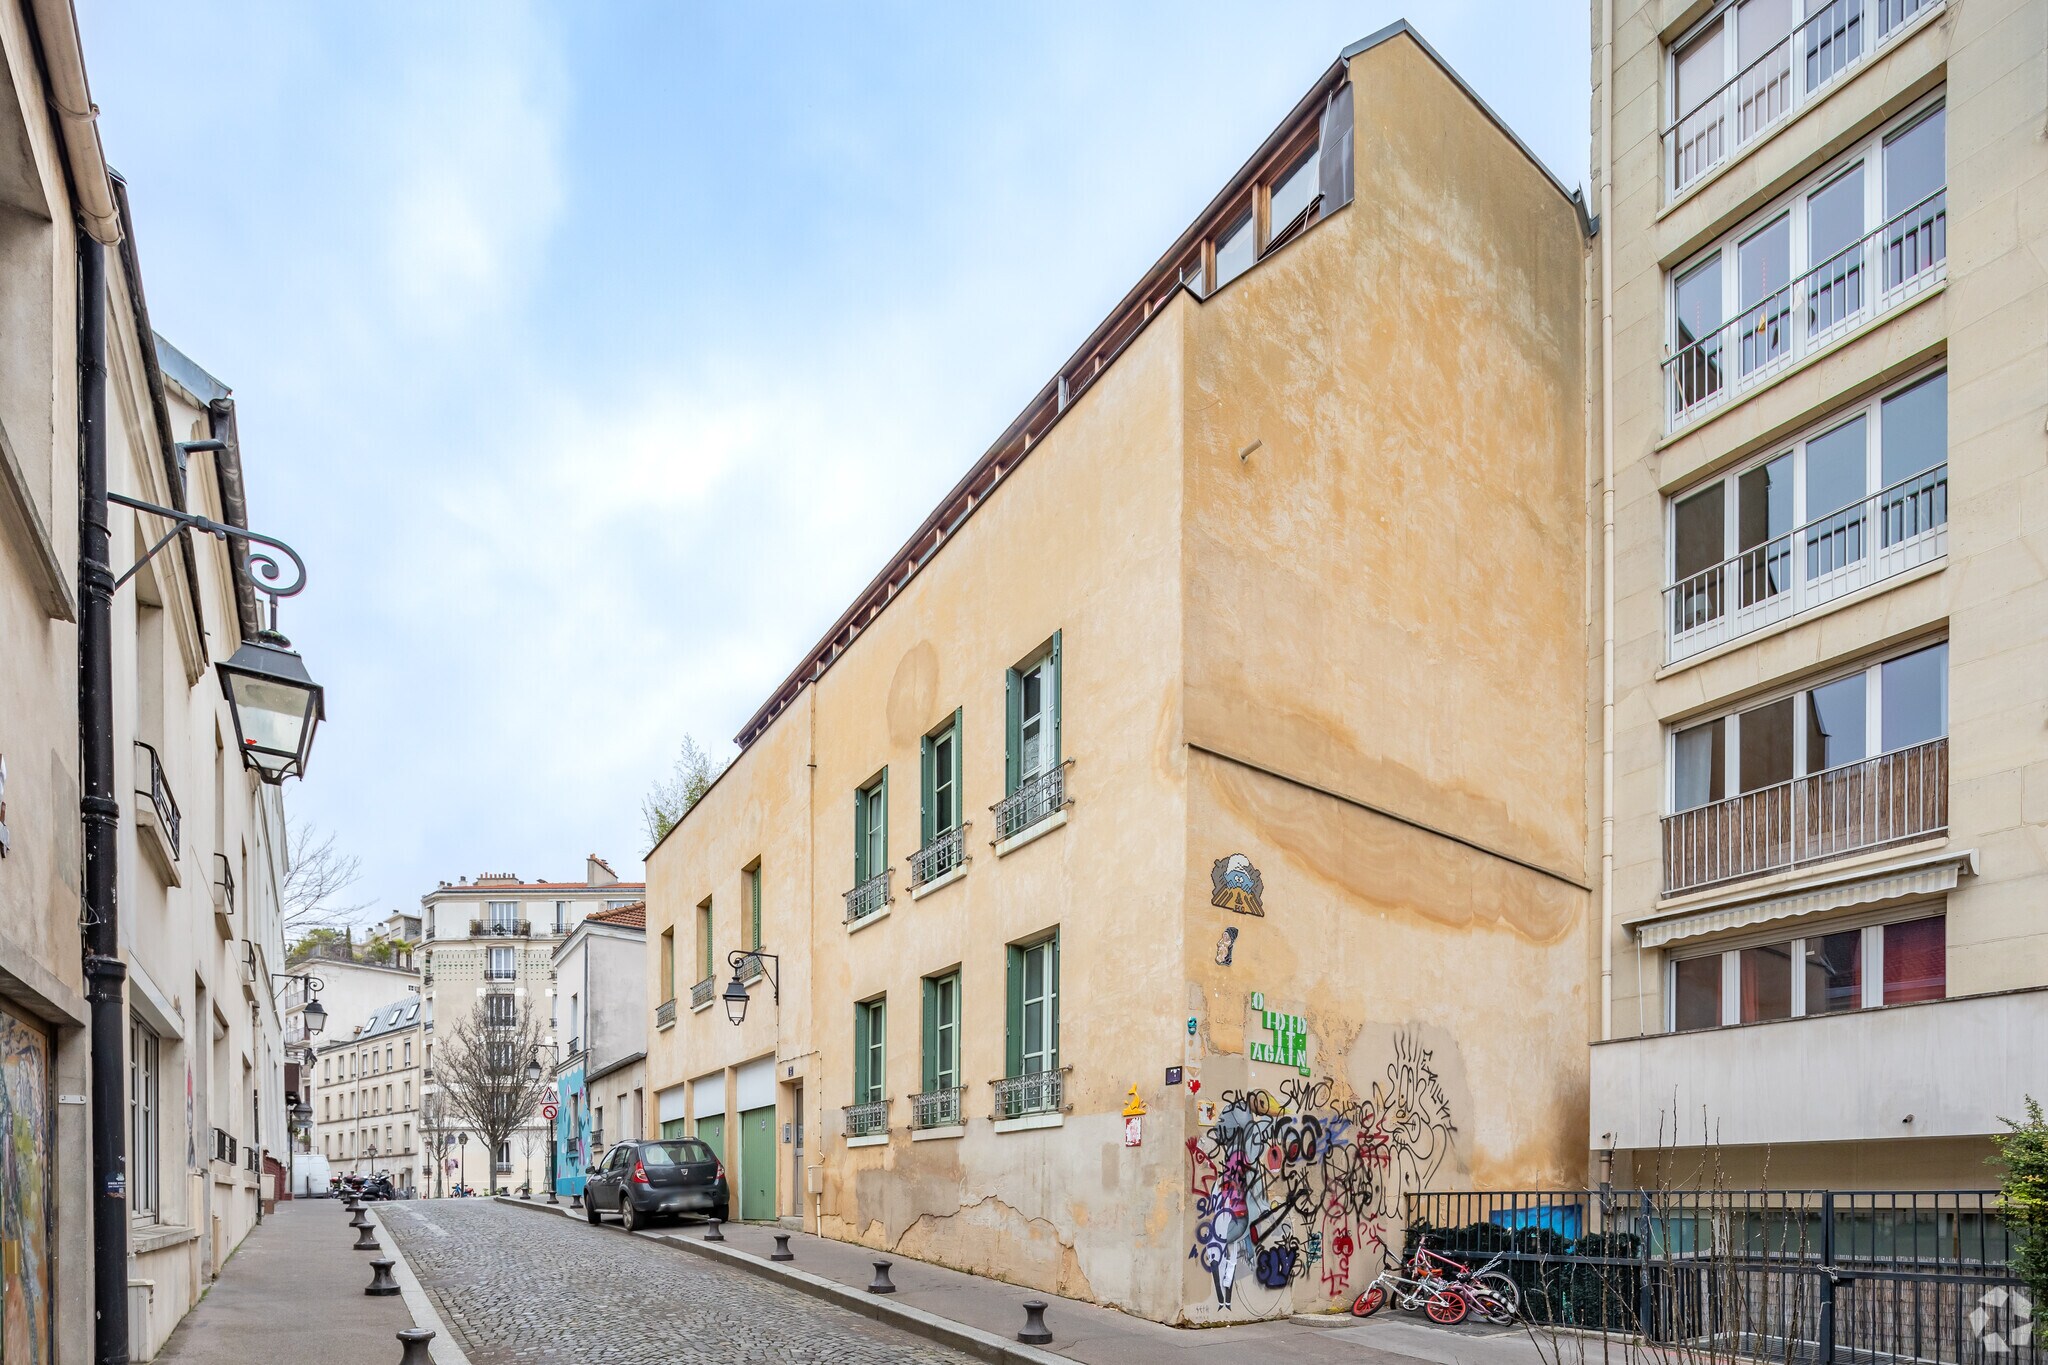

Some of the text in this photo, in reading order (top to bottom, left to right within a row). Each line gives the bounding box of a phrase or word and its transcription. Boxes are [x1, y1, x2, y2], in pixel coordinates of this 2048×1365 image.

[1253, 992, 1264, 1010] O
[1277, 1029, 1296, 1049] IT
[1252, 1042, 1306, 1068] AGAIN
